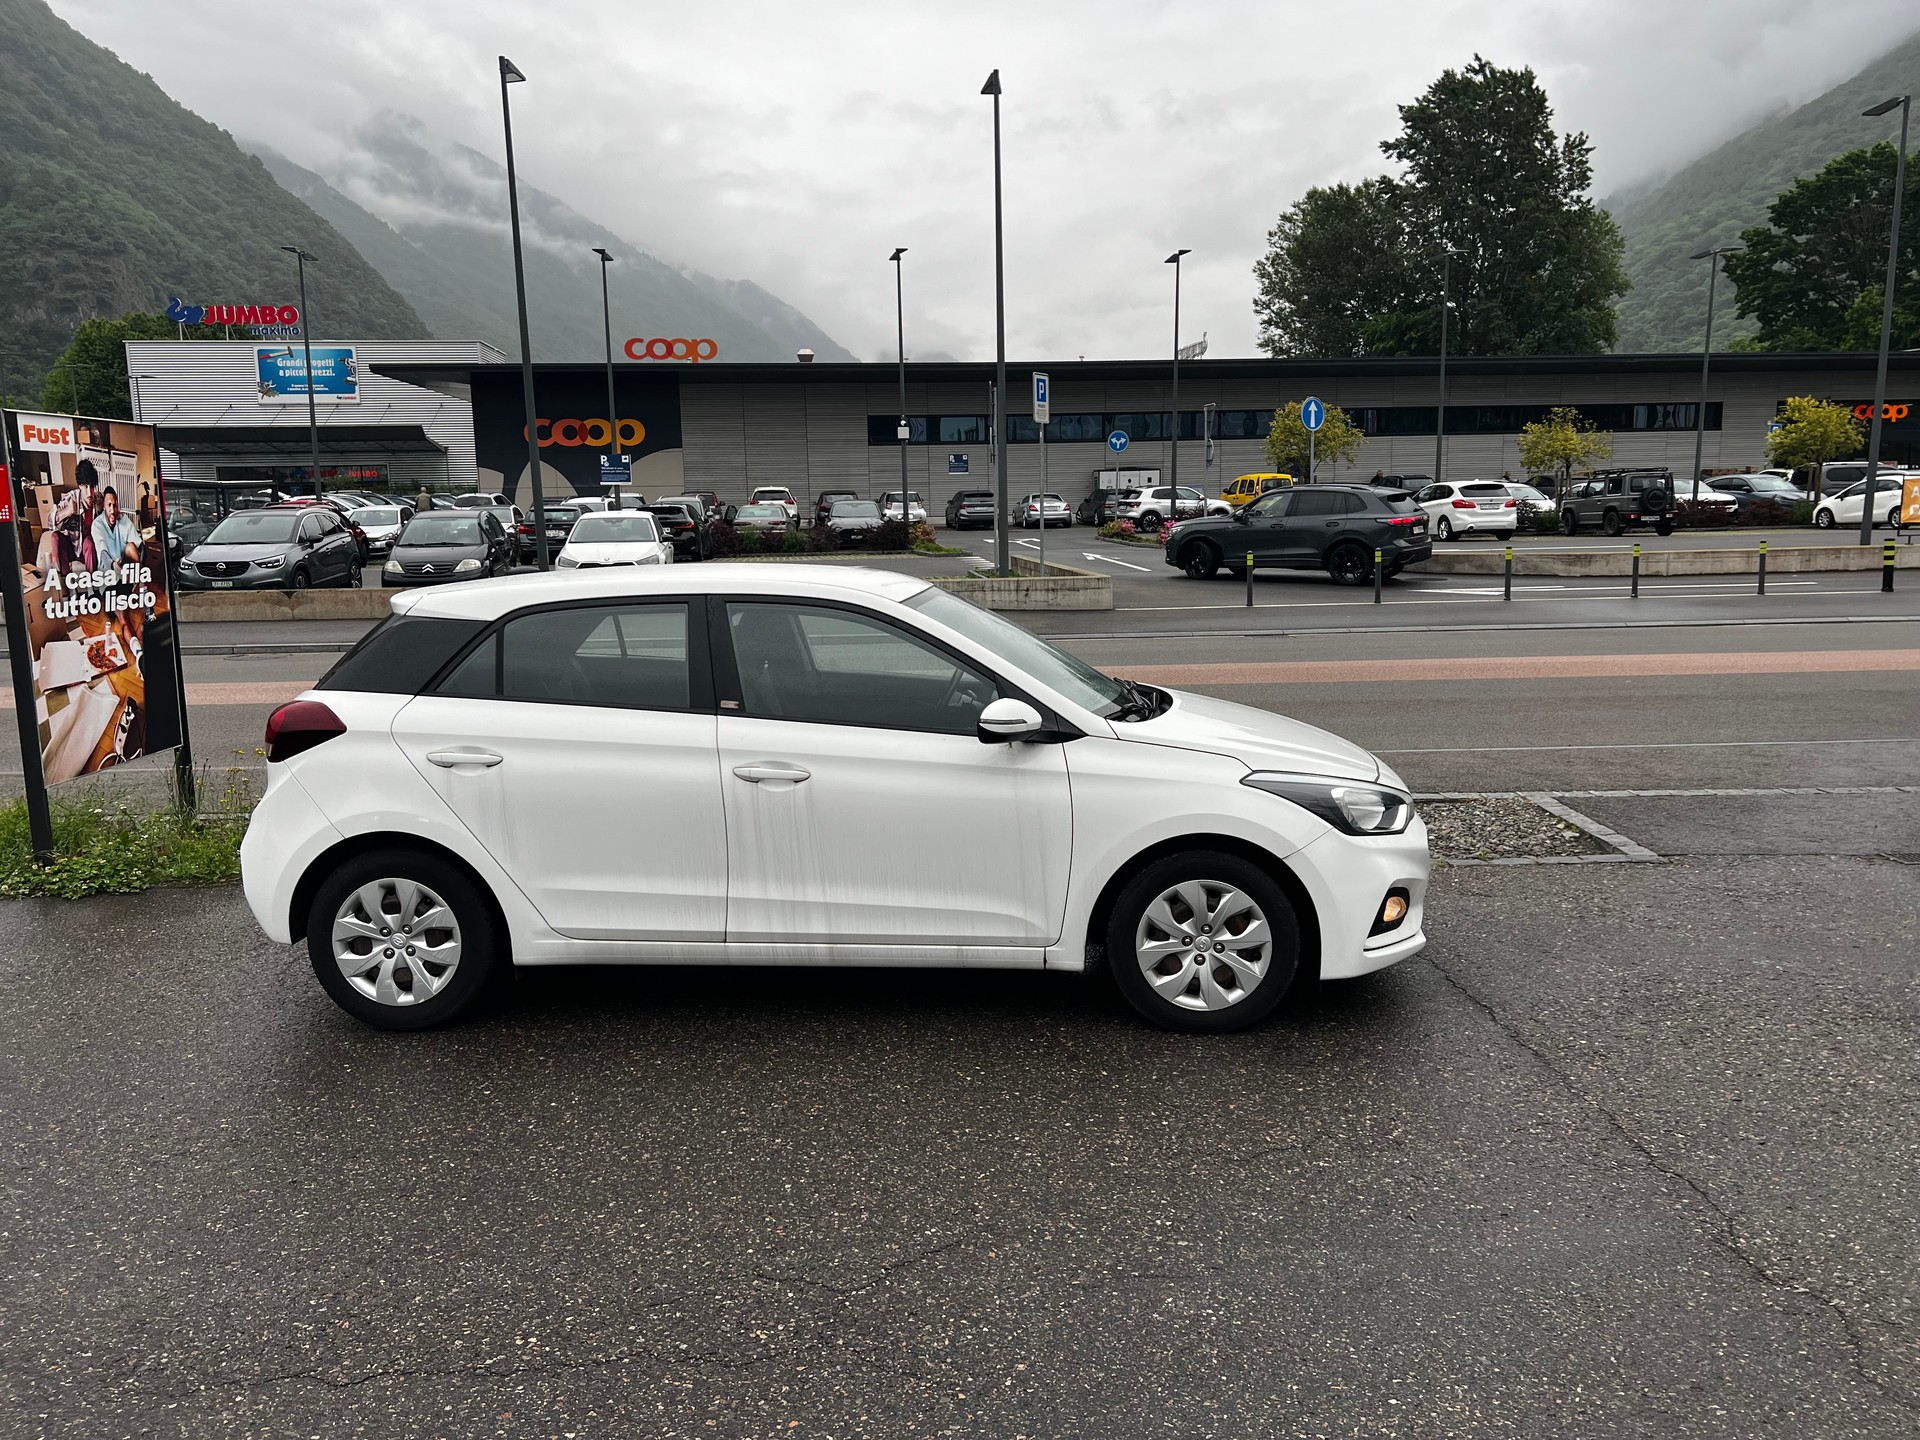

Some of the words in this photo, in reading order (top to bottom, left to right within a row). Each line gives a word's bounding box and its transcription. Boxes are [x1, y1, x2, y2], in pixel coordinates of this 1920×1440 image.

[203, 305, 300, 325] JUMBO
[250, 326, 300, 336] maximo
[624, 337, 718, 364] coop
[277, 358, 303, 366] Grandi
[1038, 382, 1045, 400] P
[23, 424, 70, 445] Fust
[523, 418, 646, 454] coop
[43, 568, 61, 591] A
[65, 569, 118, 589] casa
[120, 562, 152, 584] fila
[45, 593, 101, 619] tutto
[105, 587, 156, 612] liscio
